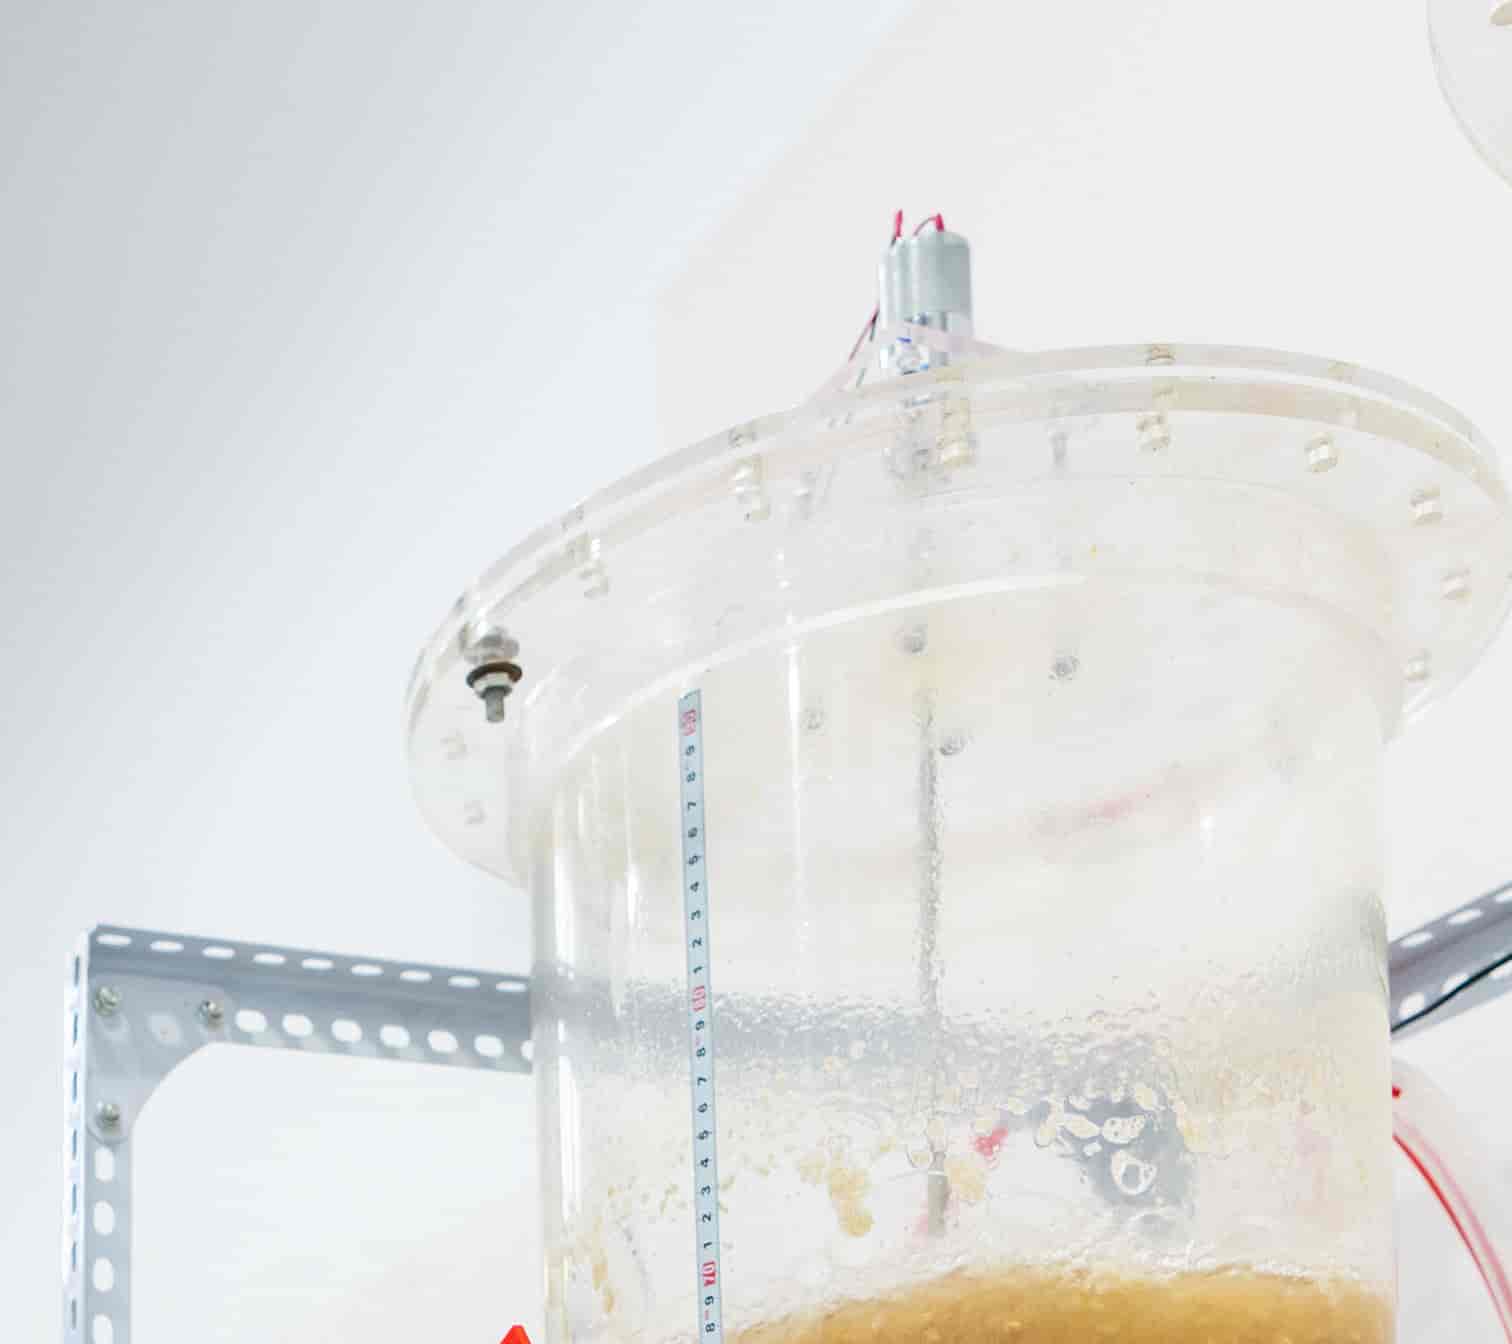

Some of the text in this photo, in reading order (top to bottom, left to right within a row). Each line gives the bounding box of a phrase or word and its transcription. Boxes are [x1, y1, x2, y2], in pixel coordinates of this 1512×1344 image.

[691, 909, 700, 920] 3
[692, 937, 701, 947] 2
[693, 965, 702, 973] 1
[695, 1019, 704, 1030] 9
[695, 1047, 705, 1057] 8
[697, 1076, 706, 1085] 7
[698, 1102, 707, 1113] 6
[699, 1129, 708, 1140] 5
[700, 1157, 709, 1168] 4
[701, 1185, 710, 1195] 3
[702, 1213, 711, 1222] 2
[704, 1295, 714, 1305] 9
[705, 1322, 715, 1332] 8
